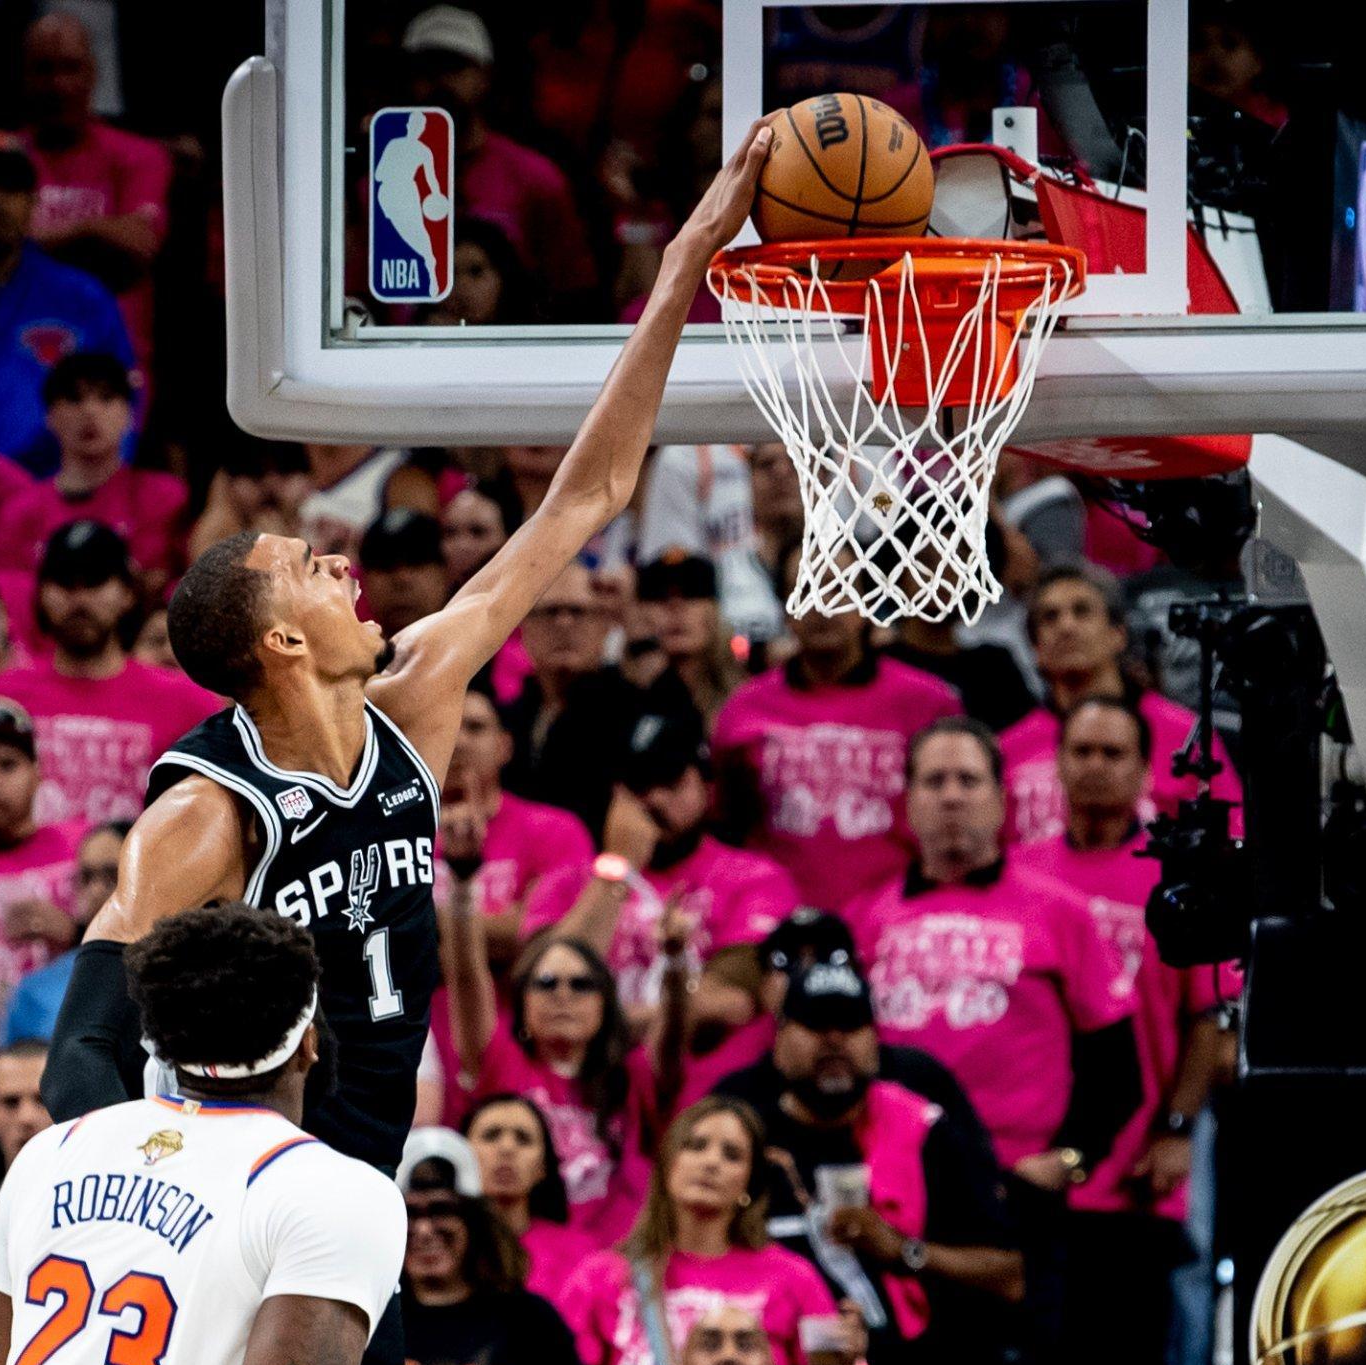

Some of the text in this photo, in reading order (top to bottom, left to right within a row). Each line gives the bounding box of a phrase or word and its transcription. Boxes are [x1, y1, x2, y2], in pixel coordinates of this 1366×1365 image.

[381, 258, 421, 290] NBA
[385, 786, 420, 809] LEDGER
[274, 836, 434, 934] SPURS
[362, 926, 405, 1023] 1
[51, 1173, 214, 1254] ROBINSON
